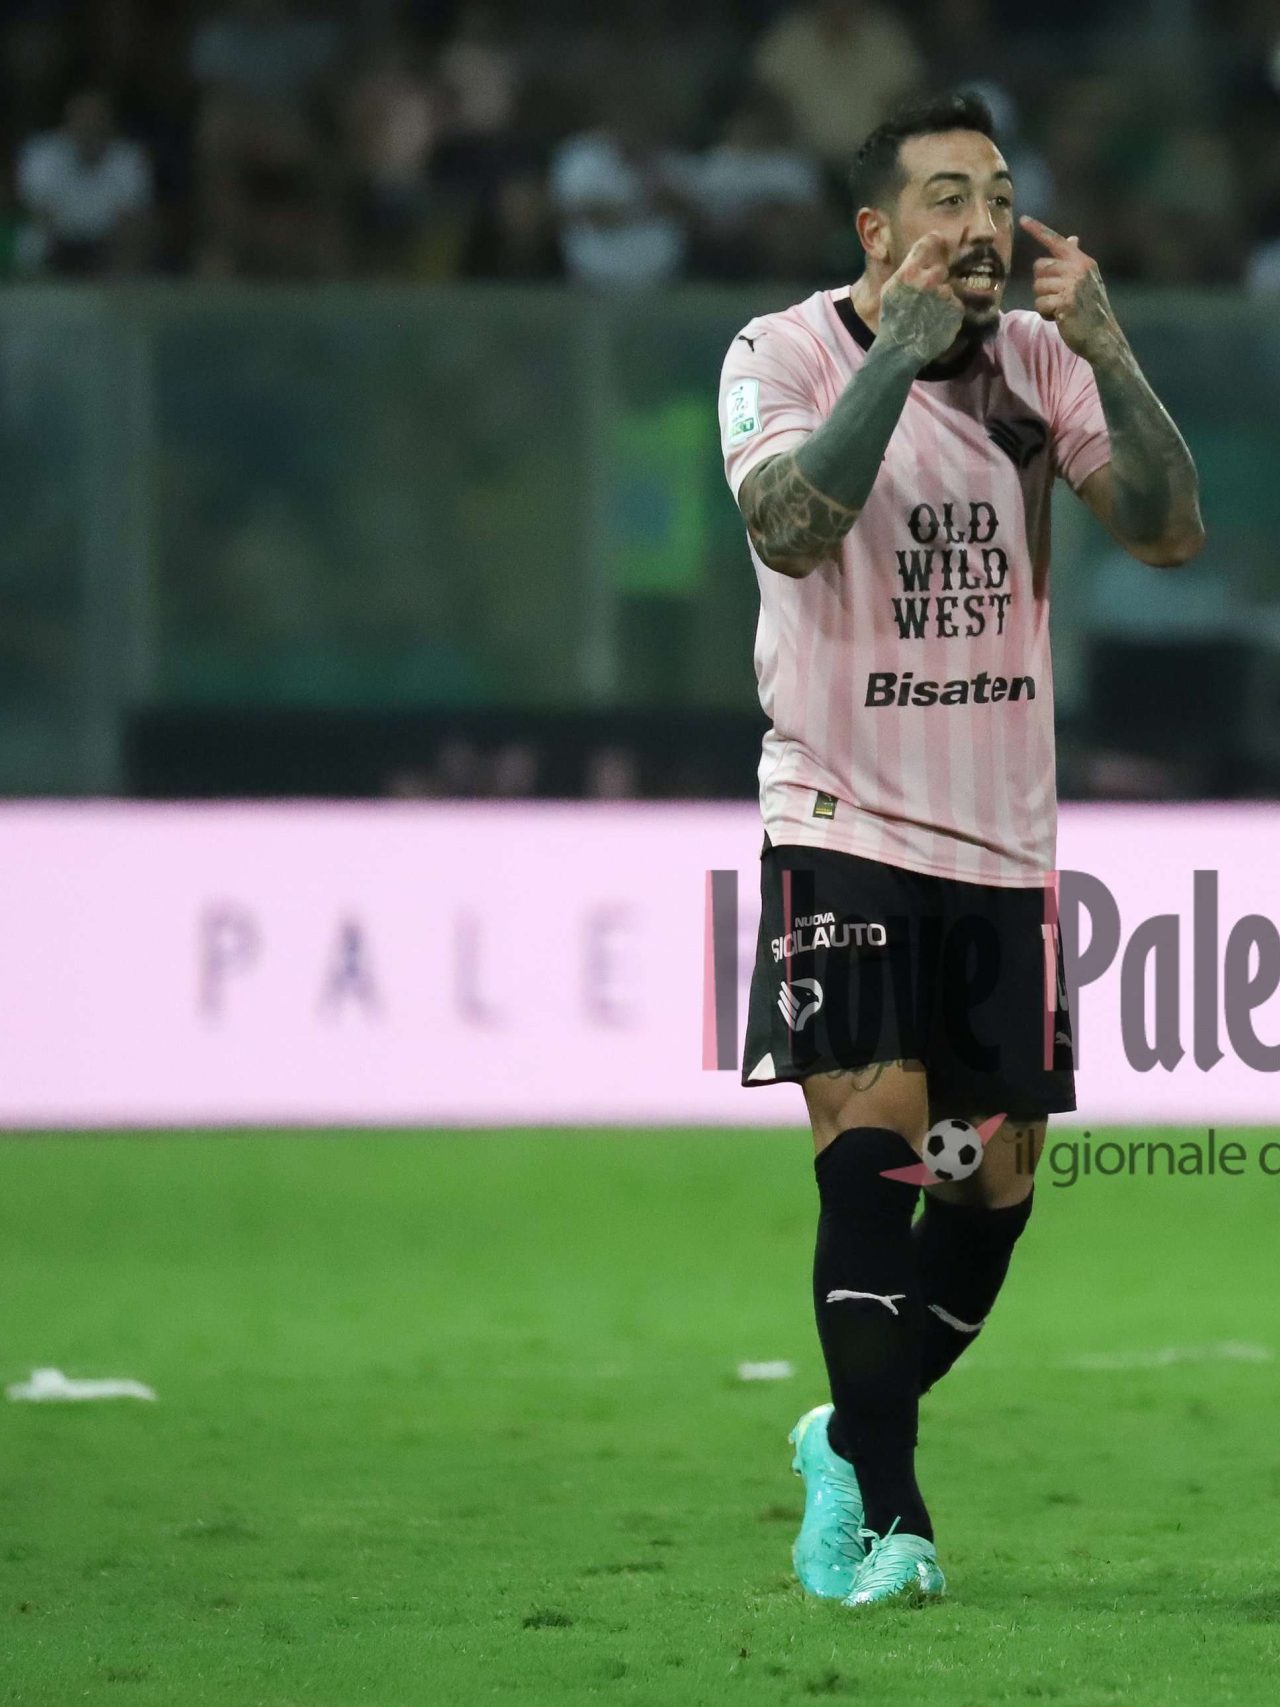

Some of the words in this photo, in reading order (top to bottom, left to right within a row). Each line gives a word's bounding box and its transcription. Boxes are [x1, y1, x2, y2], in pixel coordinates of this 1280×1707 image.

[908, 502, 999, 544] OLD
[896, 547, 1009, 592] WILD
[892, 593, 1012, 639] WEST
[864, 671, 1036, 707] Bisaten
[795, 912, 835, 928] NUOVA
[771, 923, 887, 963] SICILAUTO
